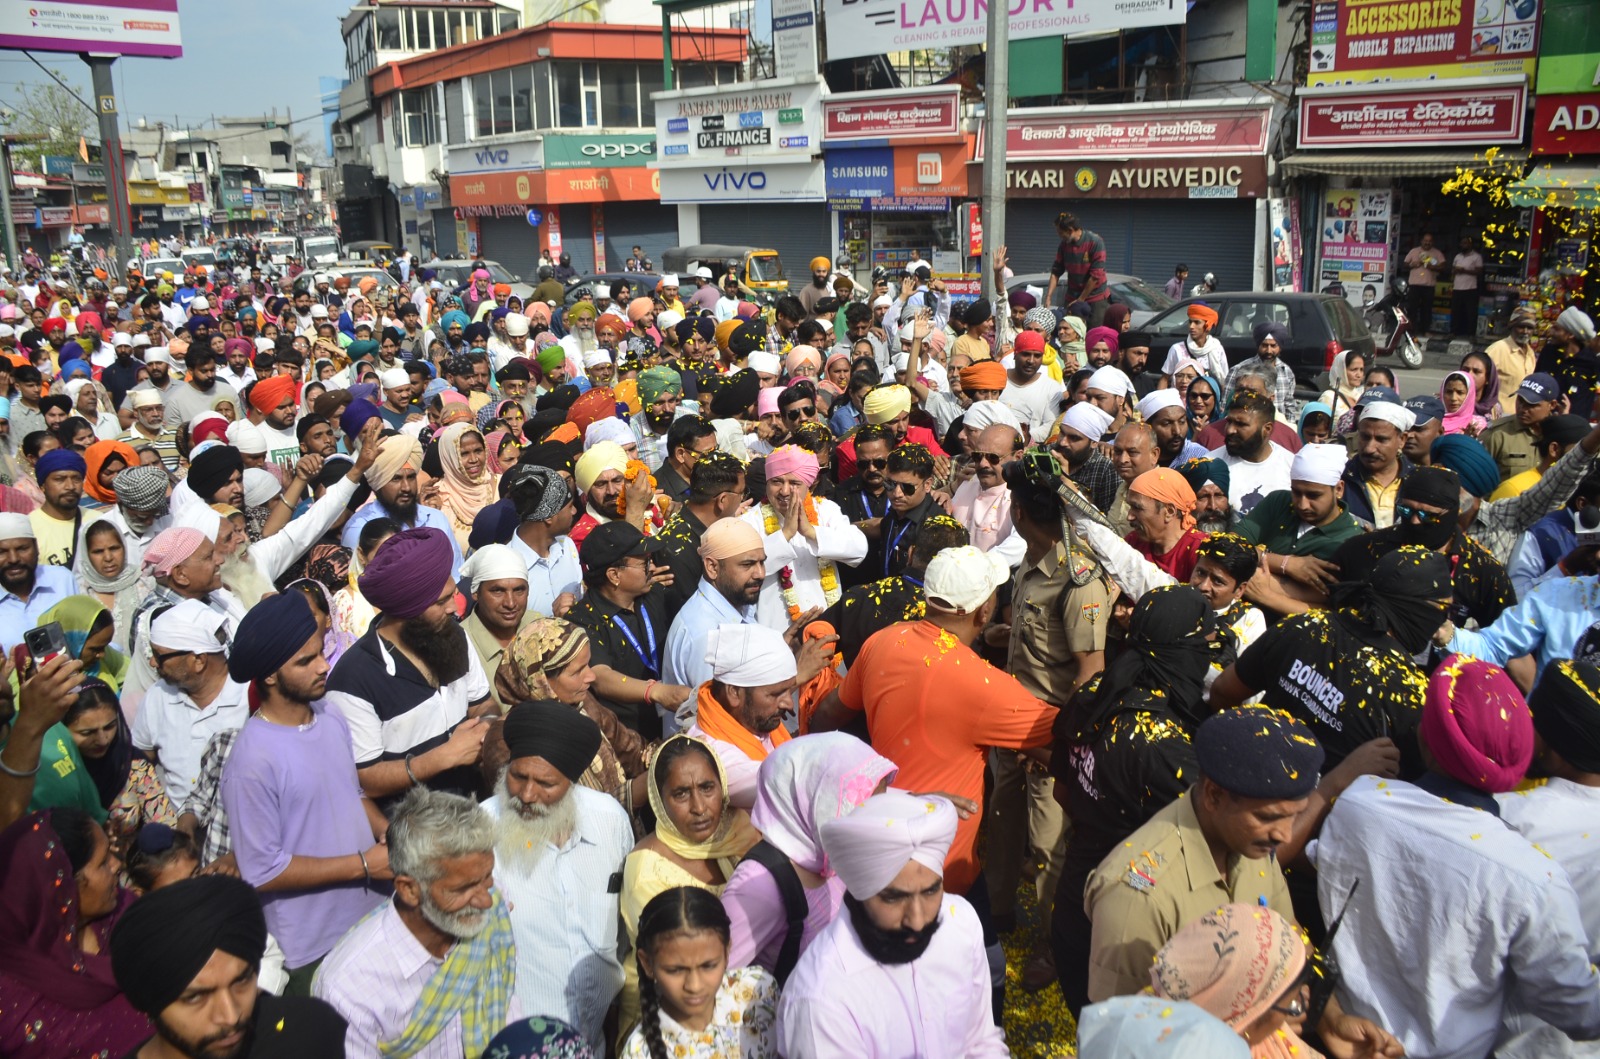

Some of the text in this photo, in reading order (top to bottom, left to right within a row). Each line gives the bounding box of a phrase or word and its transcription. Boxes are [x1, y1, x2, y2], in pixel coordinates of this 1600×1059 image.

[1346, 0, 1462, 36] ACCESSORIES
[893, 31, 939, 45] CLEANING
[951, 28, 986, 38] REPAIR
[1348, 32, 1456, 58] MOBILE REPAIRING
[740, 114, 762, 125] vivo
[1548, 104, 1600, 132] AD
[700, 129, 768, 148] 0% FINANCE
[475, 146, 509, 165] vivo
[703, 167, 767, 191] vivo
[832, 165, 888, 178] SAMSUNG
[1107, 165, 1242, 189] AYURVEDIC
[870, 197, 947, 206] MOBILE REPAIRING
[494, 204, 528, 219] TELECOM
[1325, 246, 1383, 258] MOBILE REPAIRING
[1288, 659, 1344, 714] BOUNCER
[1278, 676, 1343, 732] HAWK COMMANDOS
